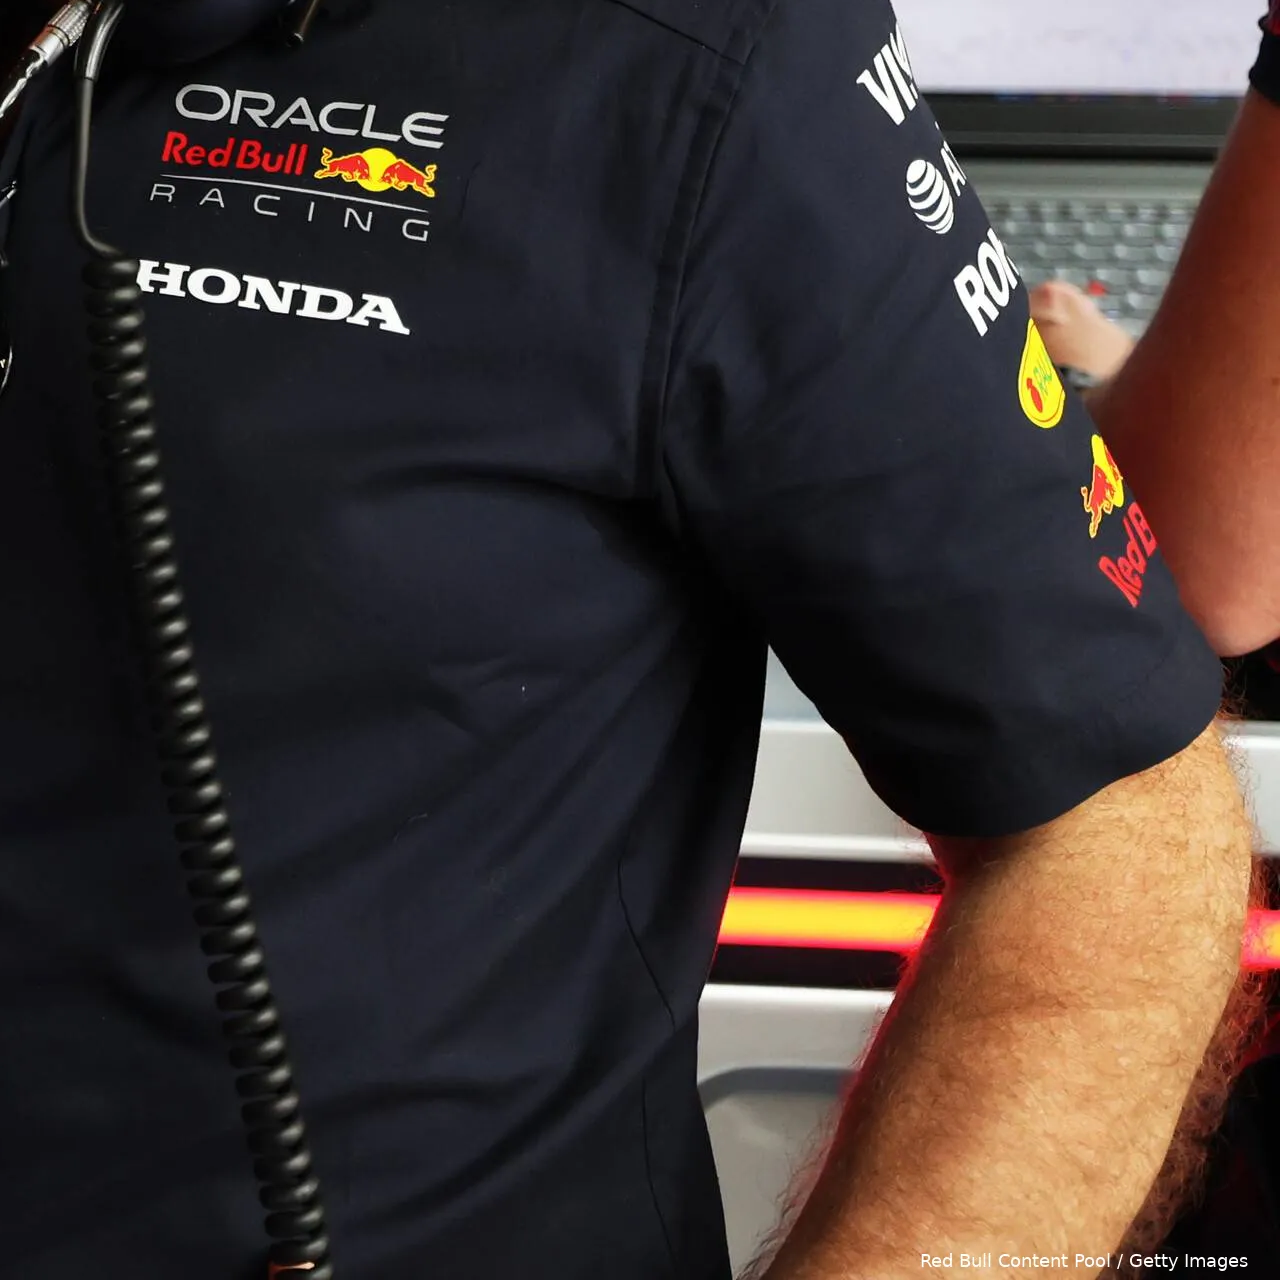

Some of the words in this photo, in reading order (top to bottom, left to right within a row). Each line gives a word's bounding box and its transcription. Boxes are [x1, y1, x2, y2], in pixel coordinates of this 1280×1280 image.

[855, 23, 919, 126] VIS
[174, 82, 450, 150] ORACLE
[160, 130, 236, 168] Red
[235, 138, 309, 177] Bull
[149, 182, 431, 243] RACING
[136, 258, 411, 336] HONDA
[953, 226, 1021, 338] ROK
